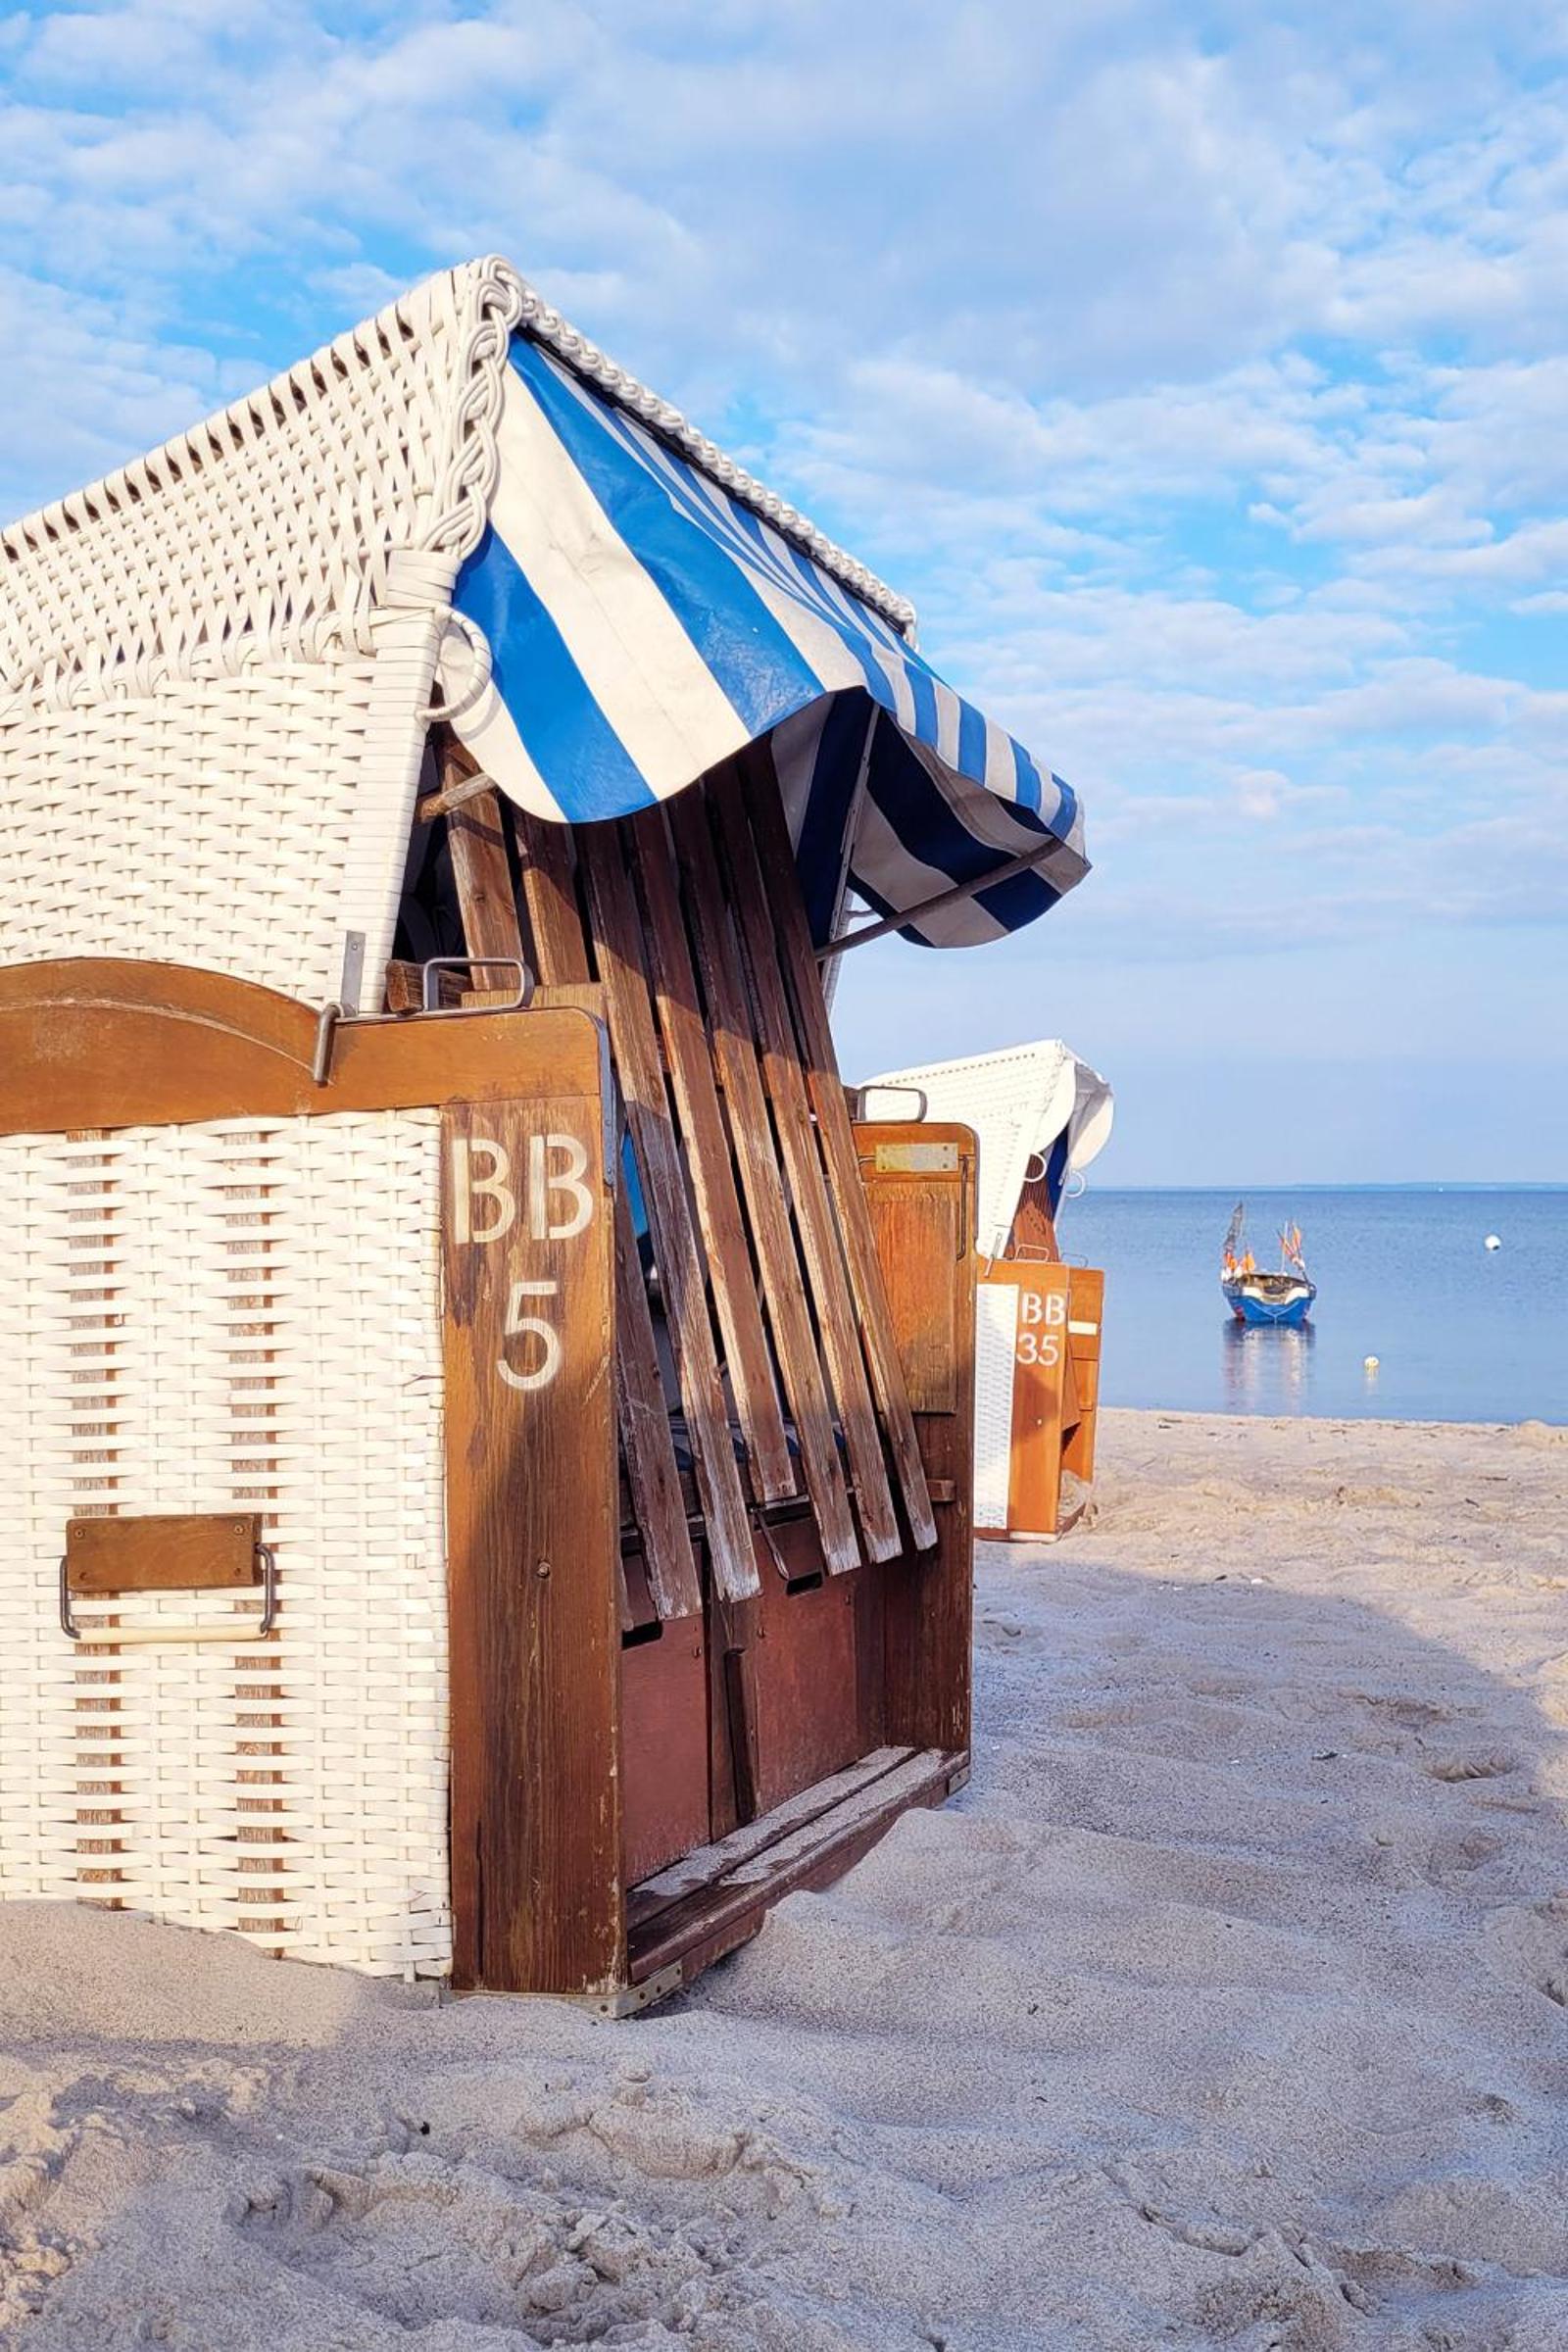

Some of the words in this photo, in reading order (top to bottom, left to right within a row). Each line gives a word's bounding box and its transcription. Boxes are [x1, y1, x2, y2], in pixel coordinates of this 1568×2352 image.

[452, 1134, 593, 1244] BB
[497, 1281, 561, 1391] 5
[1021, 1293, 1066, 1326] BB
[1016, 1333, 1058, 1366] 35
